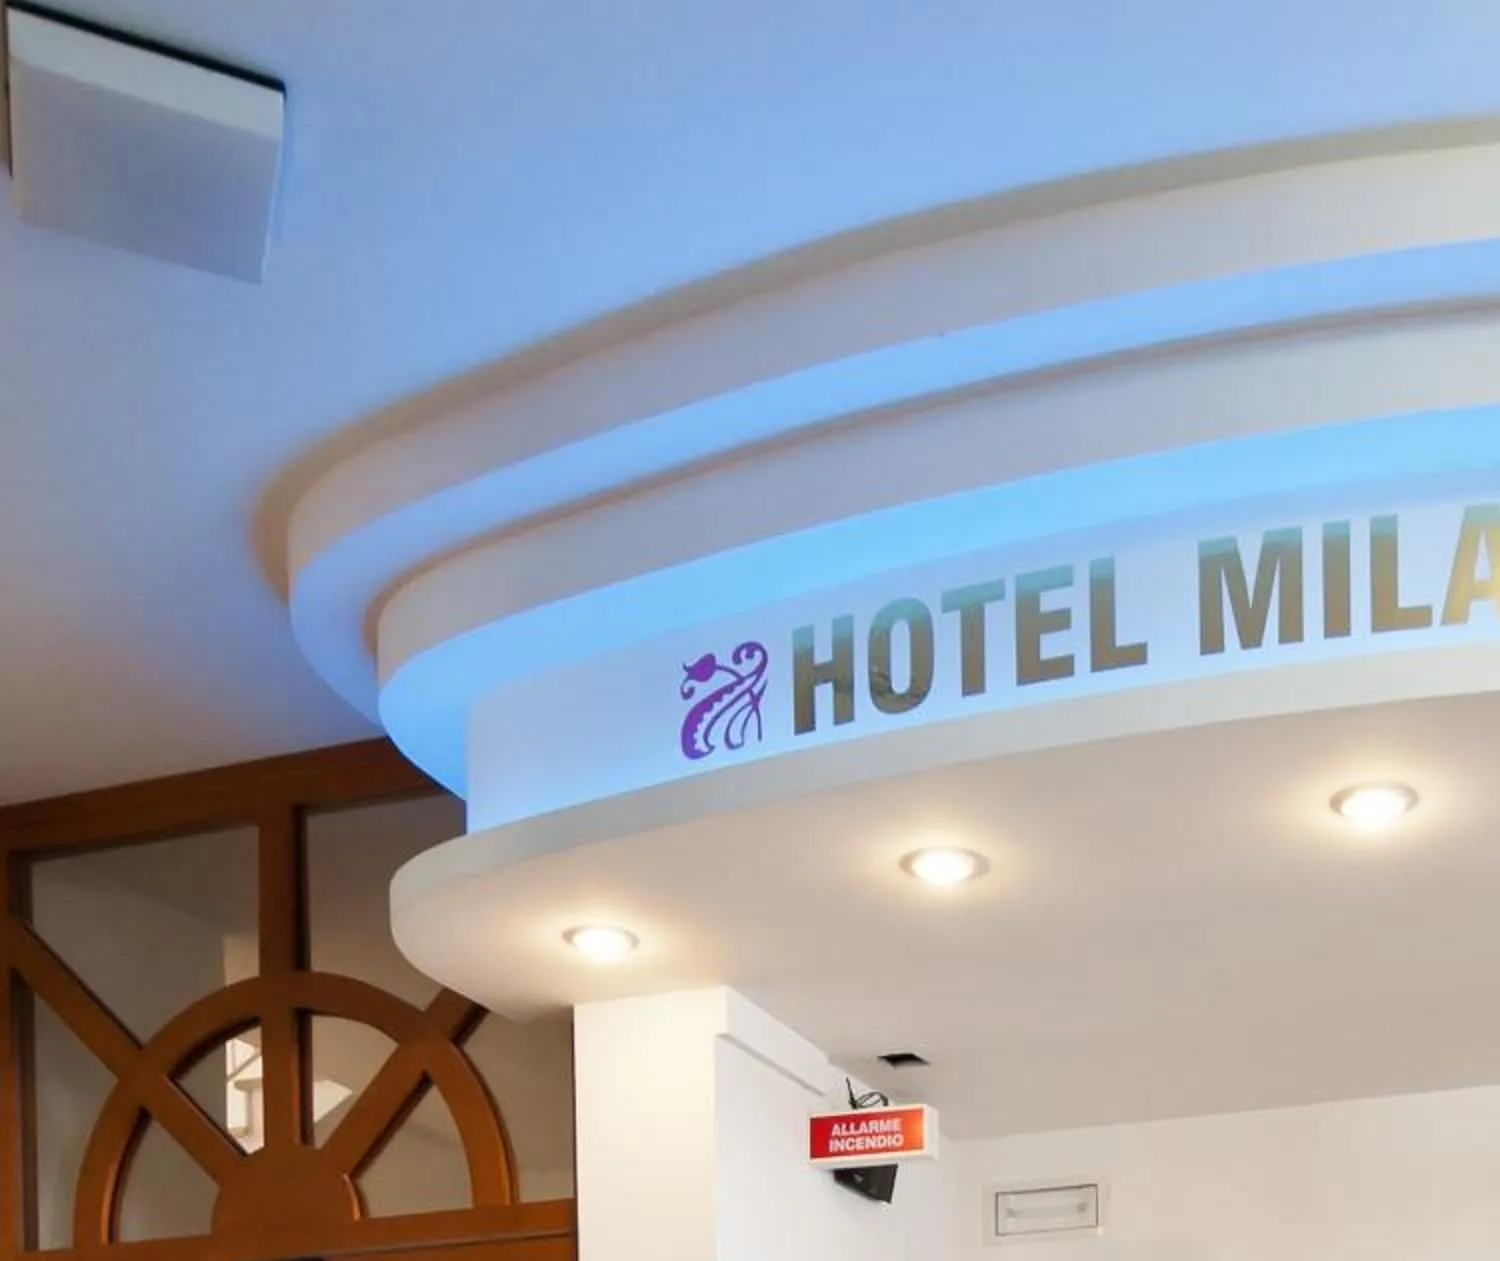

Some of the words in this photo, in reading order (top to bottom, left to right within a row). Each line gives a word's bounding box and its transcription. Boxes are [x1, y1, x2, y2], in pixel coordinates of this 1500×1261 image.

[791, 556, 1148, 736] HOTEL
[831, 1118, 902, 1135] ALLARME
[829, 1134, 904, 1152] INCENDIO
